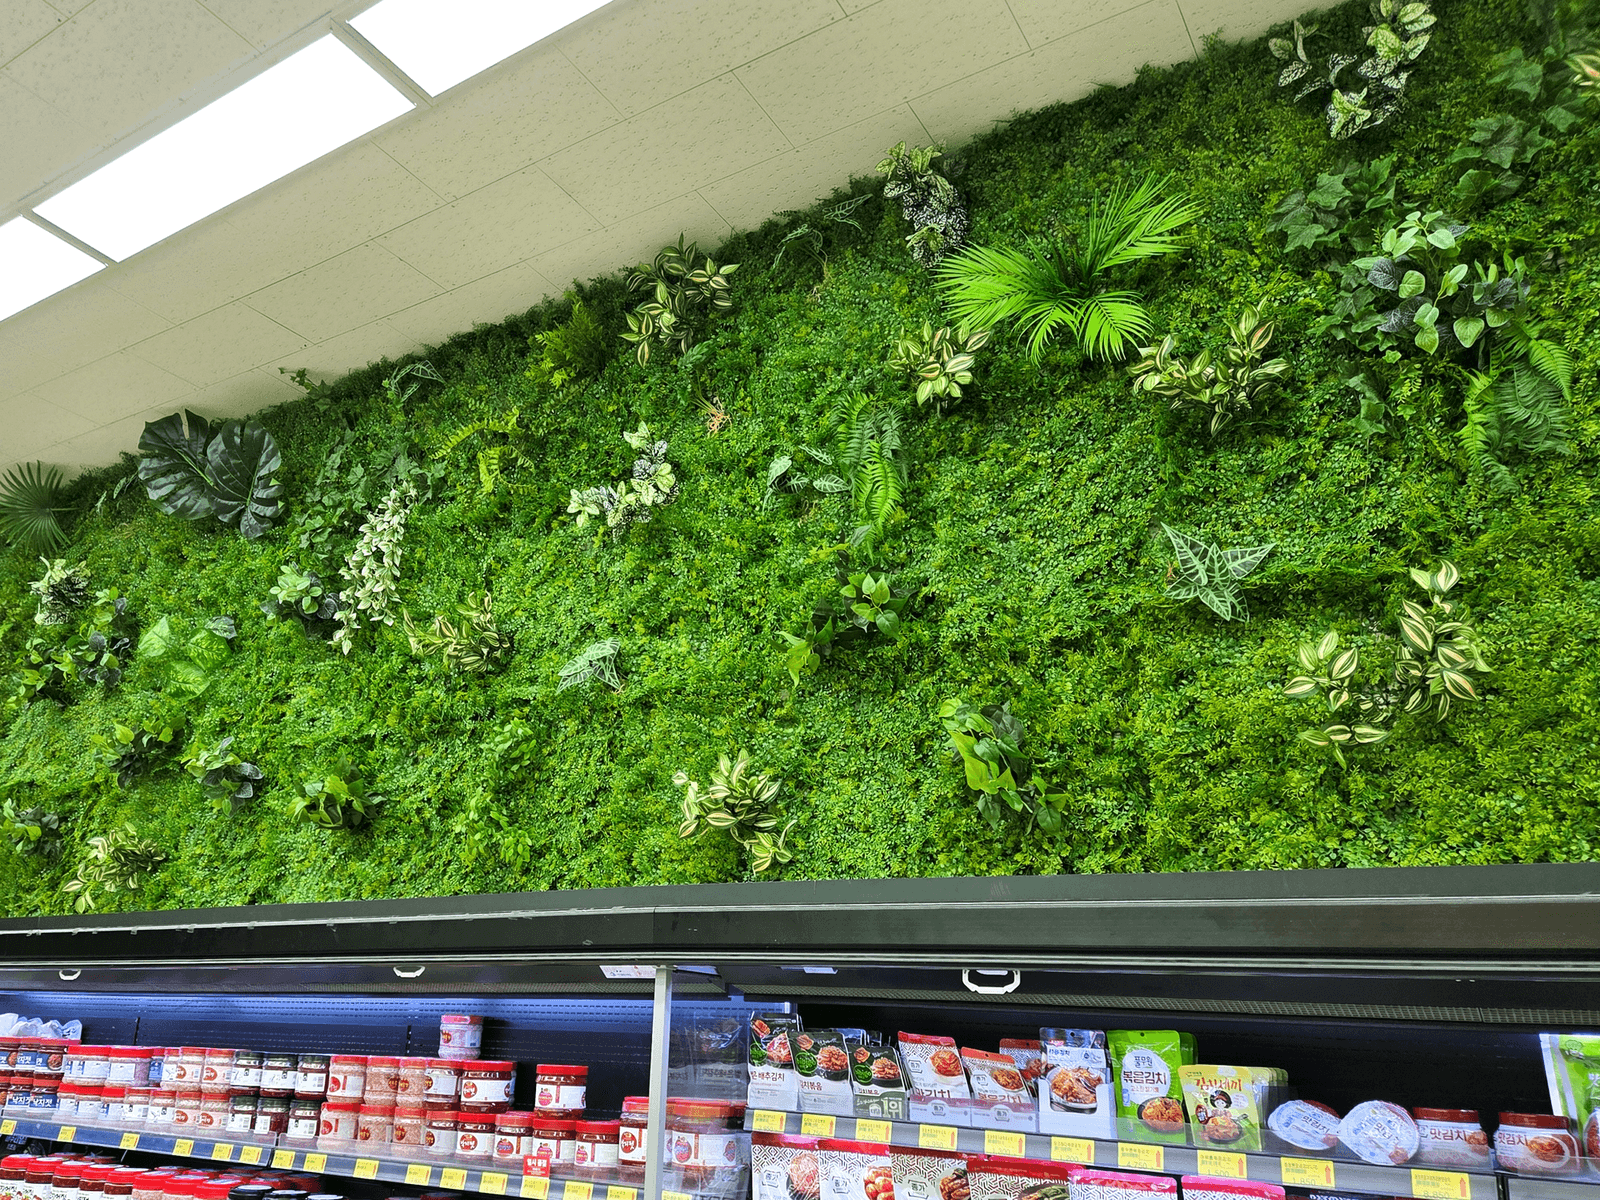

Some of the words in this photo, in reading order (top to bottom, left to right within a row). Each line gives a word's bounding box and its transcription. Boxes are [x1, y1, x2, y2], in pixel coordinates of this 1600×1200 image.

[1123, 1070, 1167, 1085] 볶음김치
[1429, 1128, 1467, 1141] 맛김치
[1498, 1131, 1528, 1147] 맛김치
